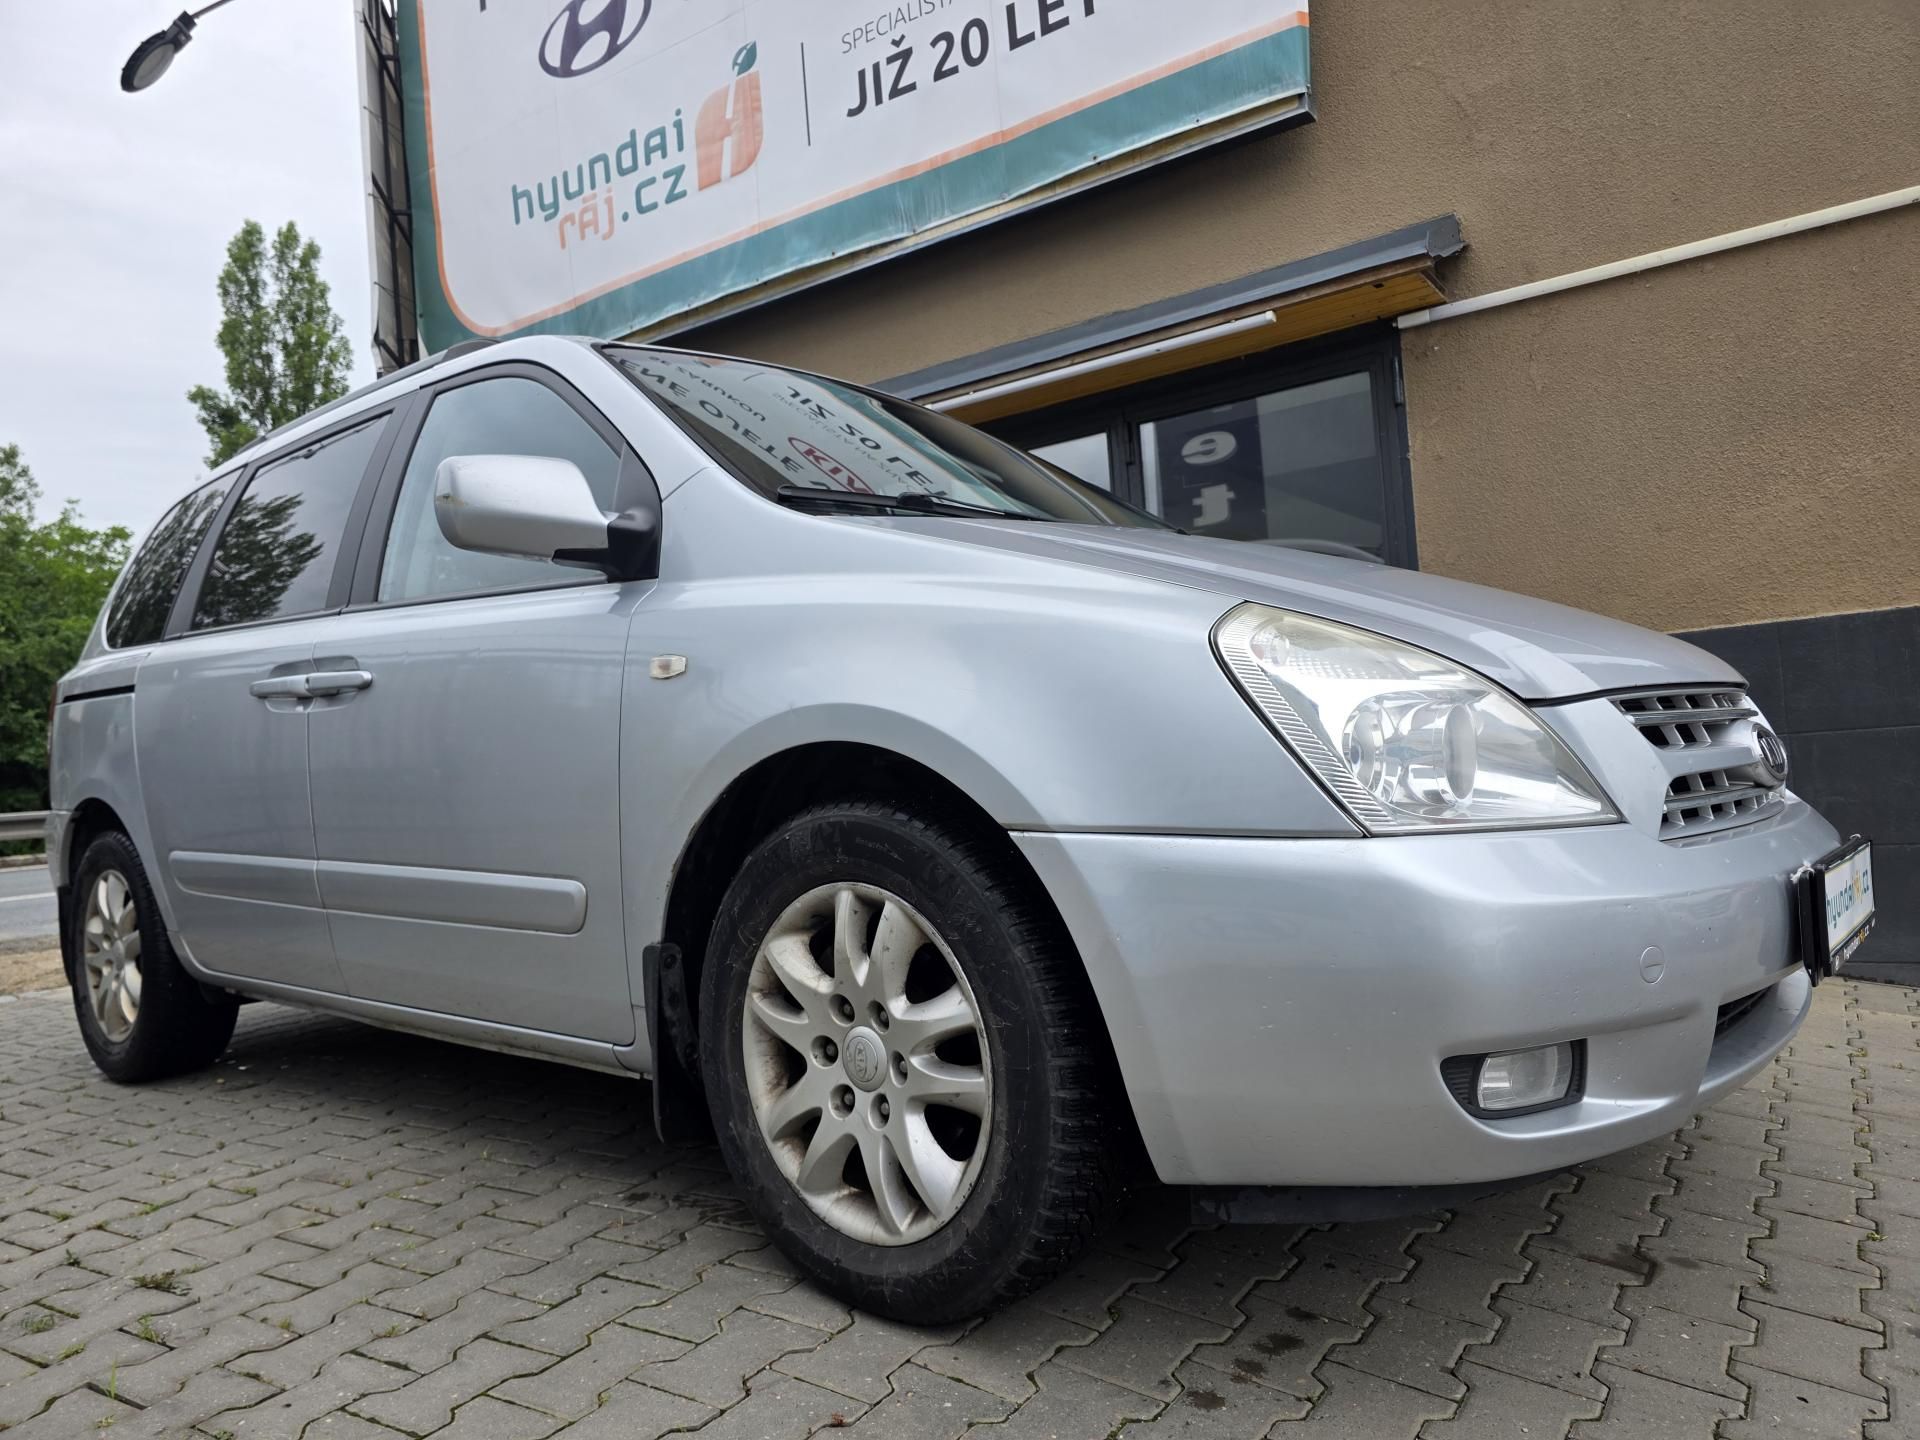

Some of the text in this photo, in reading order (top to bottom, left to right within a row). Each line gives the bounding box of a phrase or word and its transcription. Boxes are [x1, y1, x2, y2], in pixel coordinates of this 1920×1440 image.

[845, 34, 918, 118] JIŽ
[930, 17, 990, 83] 20
[511, 108, 685, 226] hyundai
